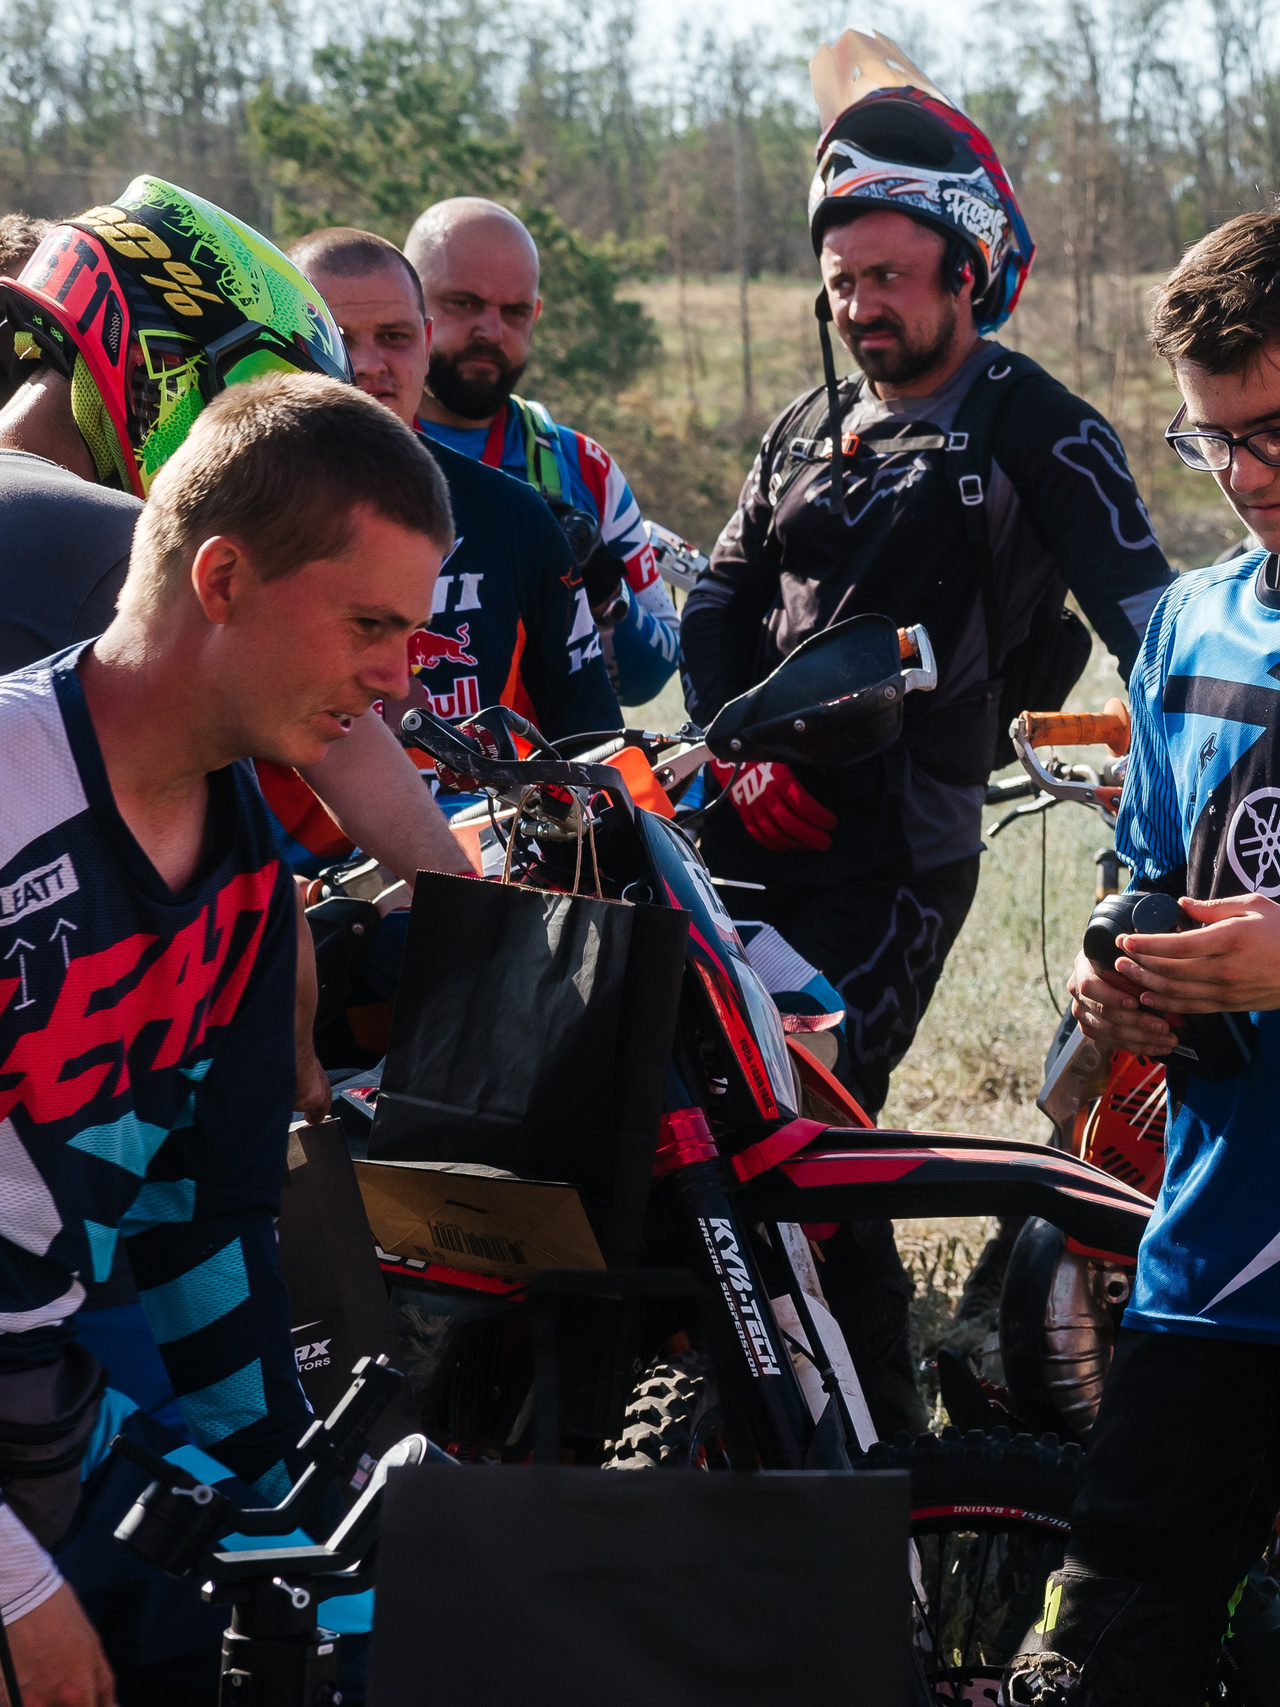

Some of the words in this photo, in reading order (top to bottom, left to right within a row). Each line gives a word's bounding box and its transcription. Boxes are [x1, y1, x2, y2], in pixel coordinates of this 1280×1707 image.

[731, 761, 775, 806] FOX
[697, 1217, 724, 1281] RACING
[718, 1280, 760, 1378] SUSPENSION
[709, 1217, 781, 1377] KYB-TECH
[953, 1505, 1004, 1515] RACING
